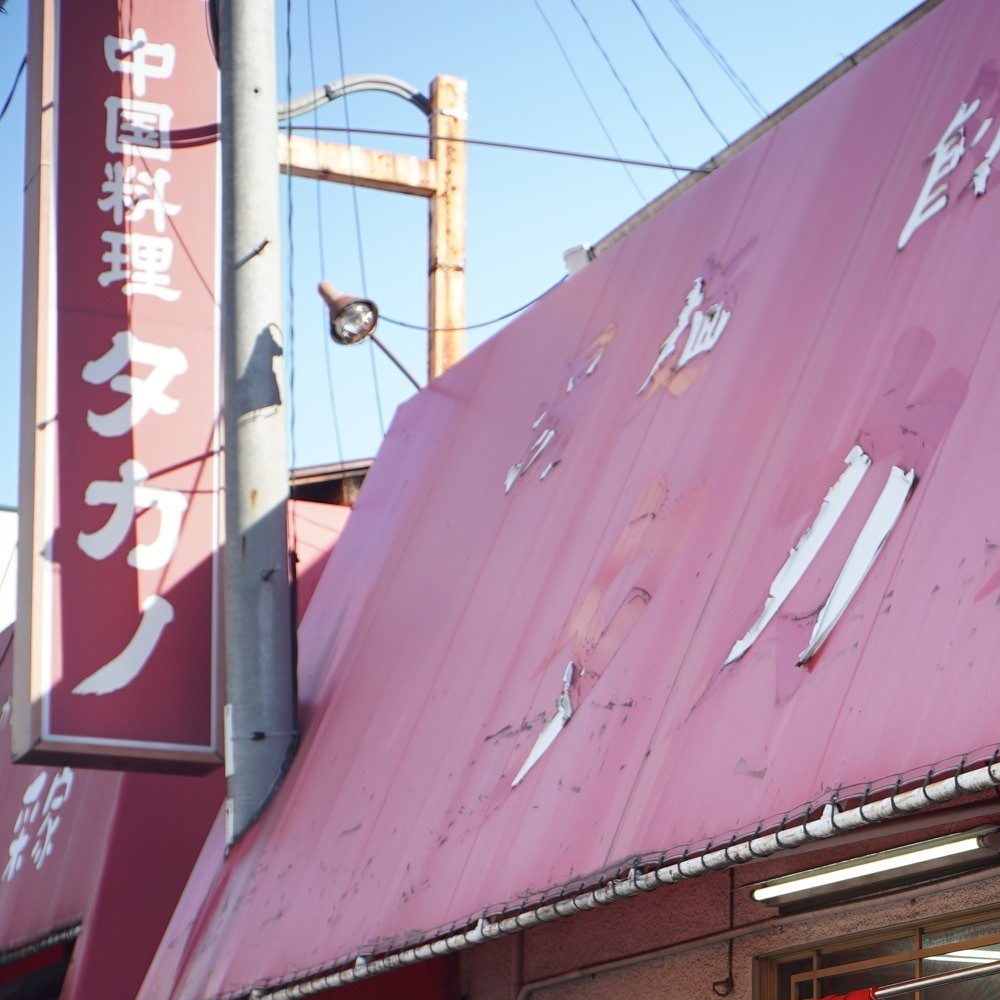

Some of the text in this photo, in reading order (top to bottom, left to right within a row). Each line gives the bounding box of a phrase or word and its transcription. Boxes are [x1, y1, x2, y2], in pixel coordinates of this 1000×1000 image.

[72, 27, 189, 696] 中国料理 タカノ
